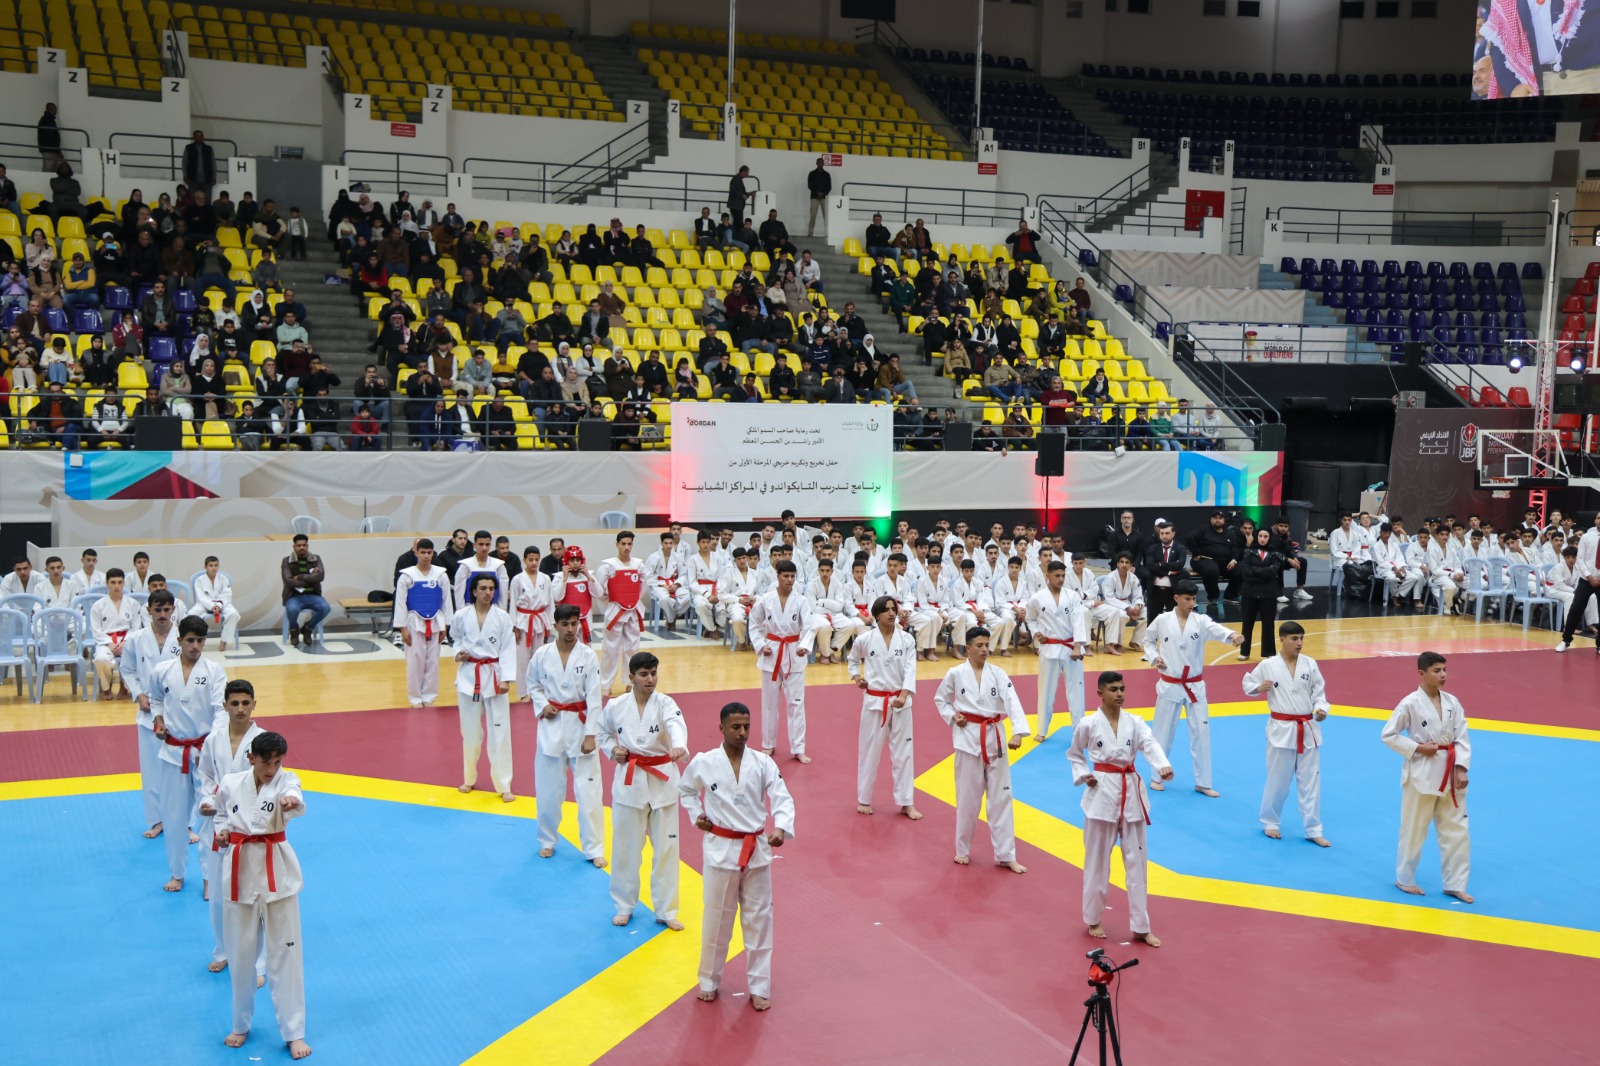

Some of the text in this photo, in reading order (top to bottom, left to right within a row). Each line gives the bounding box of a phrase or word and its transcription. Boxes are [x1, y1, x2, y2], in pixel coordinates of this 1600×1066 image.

[47, 51, 57, 63] Z
[68, 72, 78, 83] Z
[171, 81, 180, 92] Z
[436, 88, 444, 99] Z
[354, 97, 363, 108] Z
[430, 102, 439, 113] Z
[634, 104, 641, 114] Z
[670, 103, 678, 113] Z
[984, 144, 994, 152] A1
[1138, 140, 1146, 150] B1
[1182, 140, 1190, 149] B1
[1226, 142, 1234, 152] B1
[106, 153, 116, 165] H
[237, 161, 247, 172] H
[1382, 167, 1390, 176] B1
[836, 199, 843, 209] J
[1030, 210, 1036, 220] J
[1271, 223, 1278, 232] K
[746, 426, 760, 435] الملكي
[1420, 440, 1449, 449] لكرة
[1461, 448, 1476, 458] JBF
[754, 459, 771, 467] المرحلة
[773, 460, 789, 468] خريجي
[791, 459, 808, 468] وتكريم
[809, 459, 825, 468] تخريج
[682, 481, 881, 494] برنامج تدريب التايكواندو في المراكز الشبابية
[488, 636, 497, 645] 42
[1190, 633, 1200, 641] 18
[195, 677, 207, 685] 32
[990, 687, 997, 697] 8
[1447, 709, 1451, 718] 7
[649, 724, 660, 734] 44
[260, 801, 274, 812] 20
